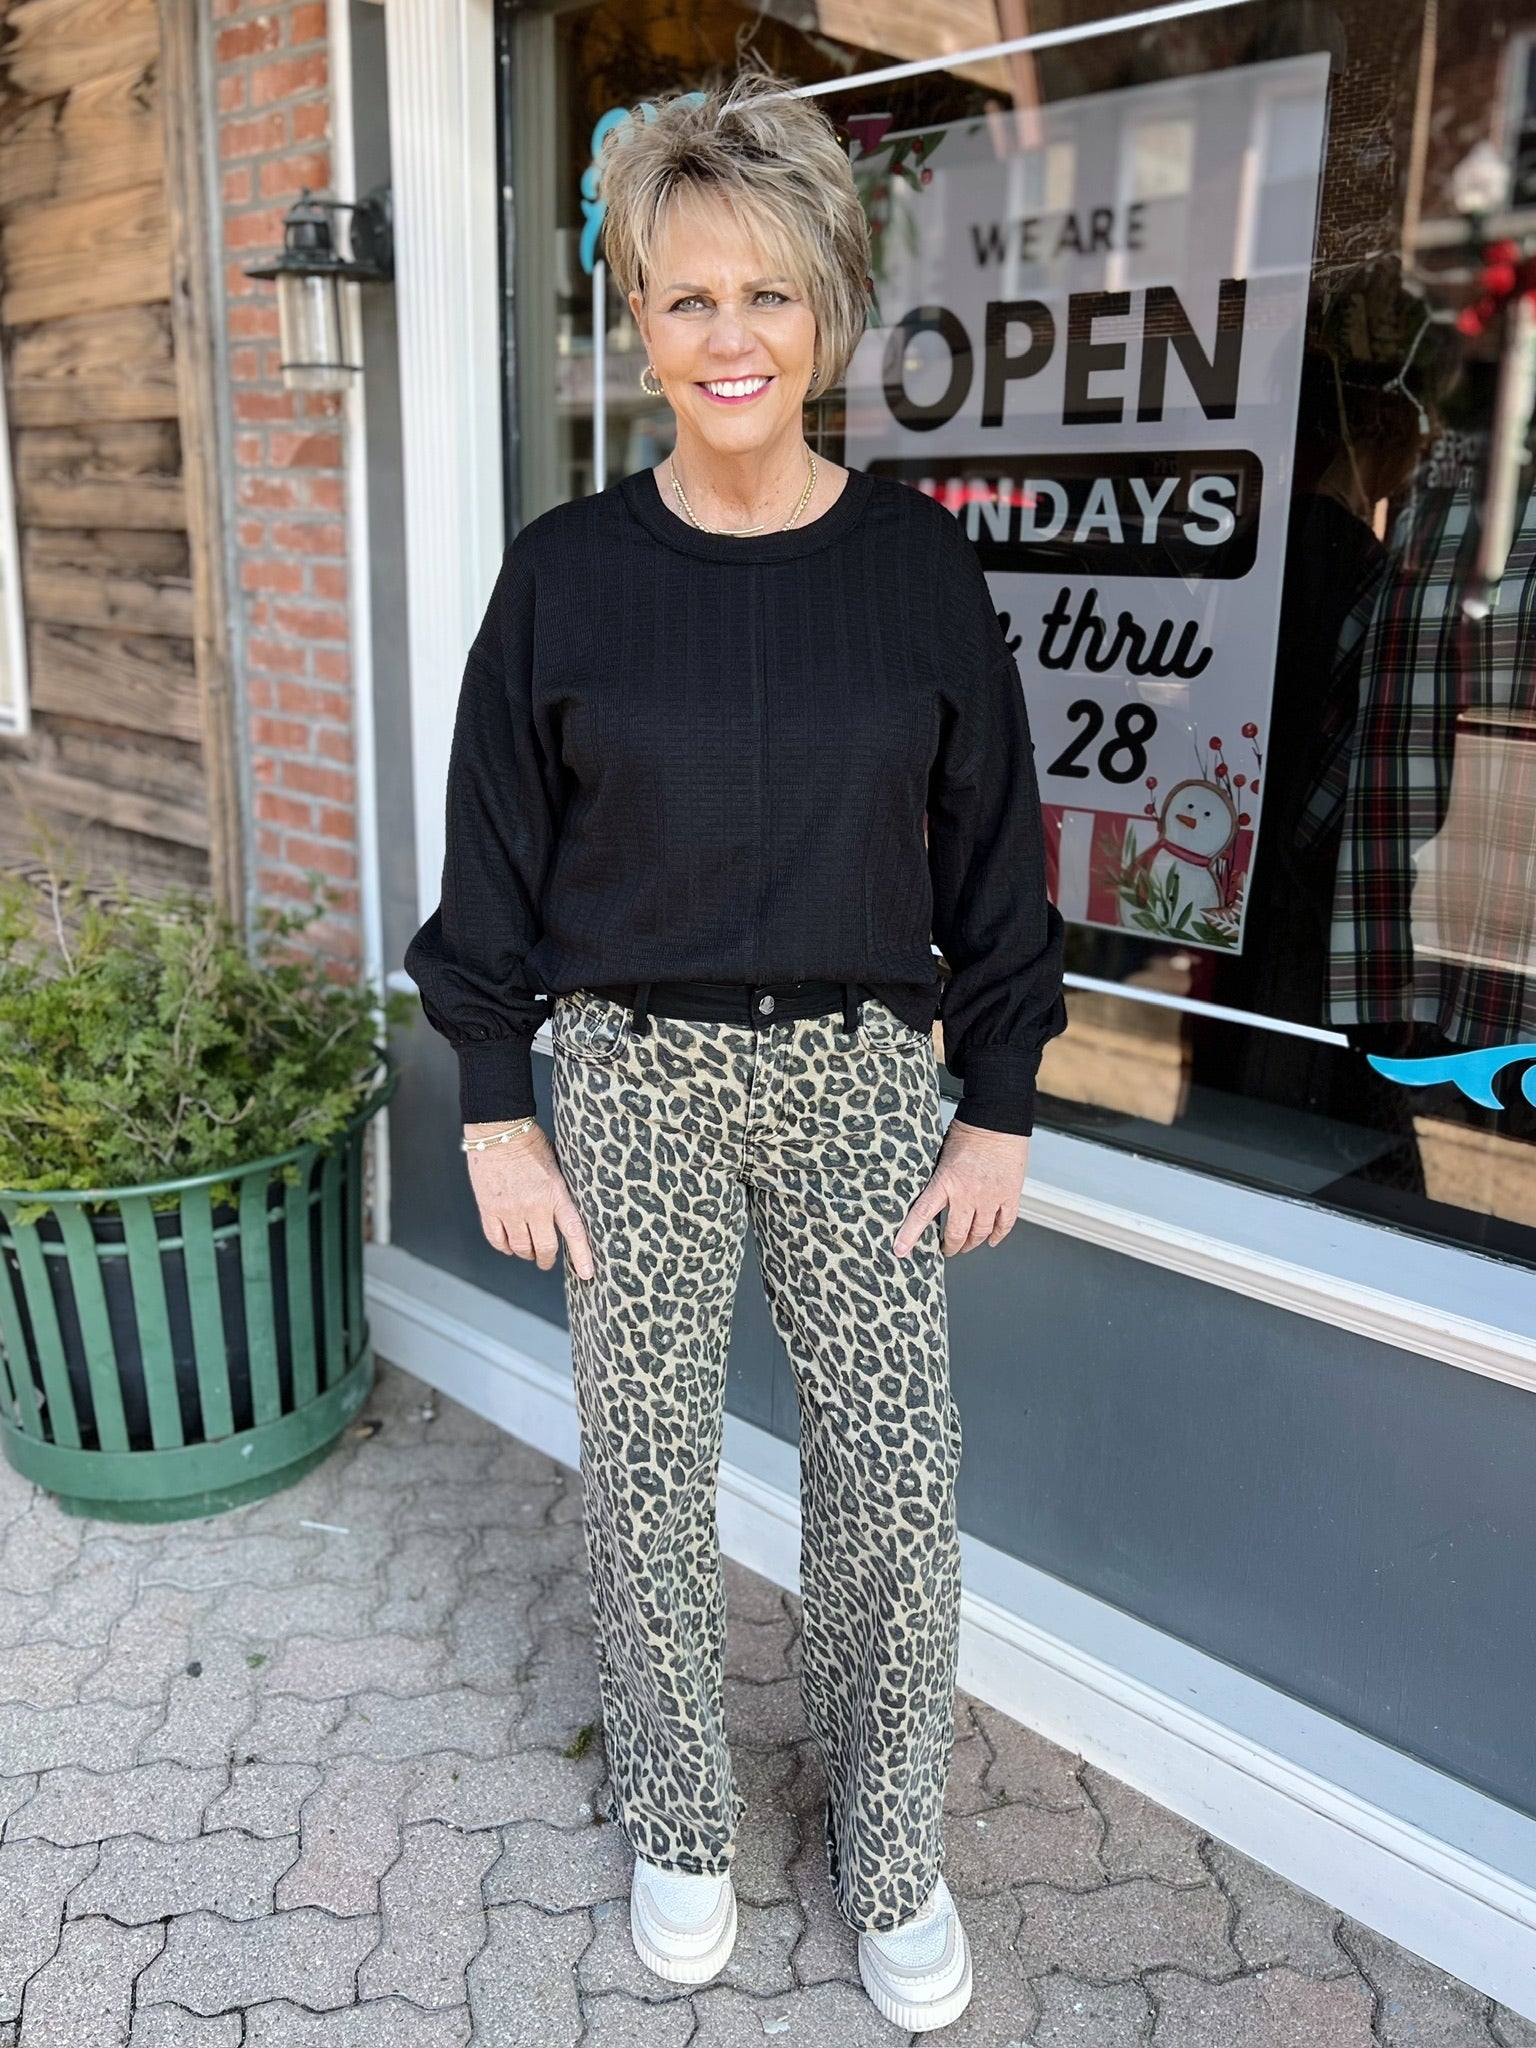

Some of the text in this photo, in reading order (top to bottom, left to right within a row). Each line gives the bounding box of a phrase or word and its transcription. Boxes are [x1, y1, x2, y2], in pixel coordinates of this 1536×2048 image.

[971, 203, 1147, 267] WE ARE
[883, 278, 1247, 432] OPEN
[917, 476, 1237, 546] NDAYS
[1038, 586, 1213, 679] thru
[1046, 699, 1158, 784] 28
